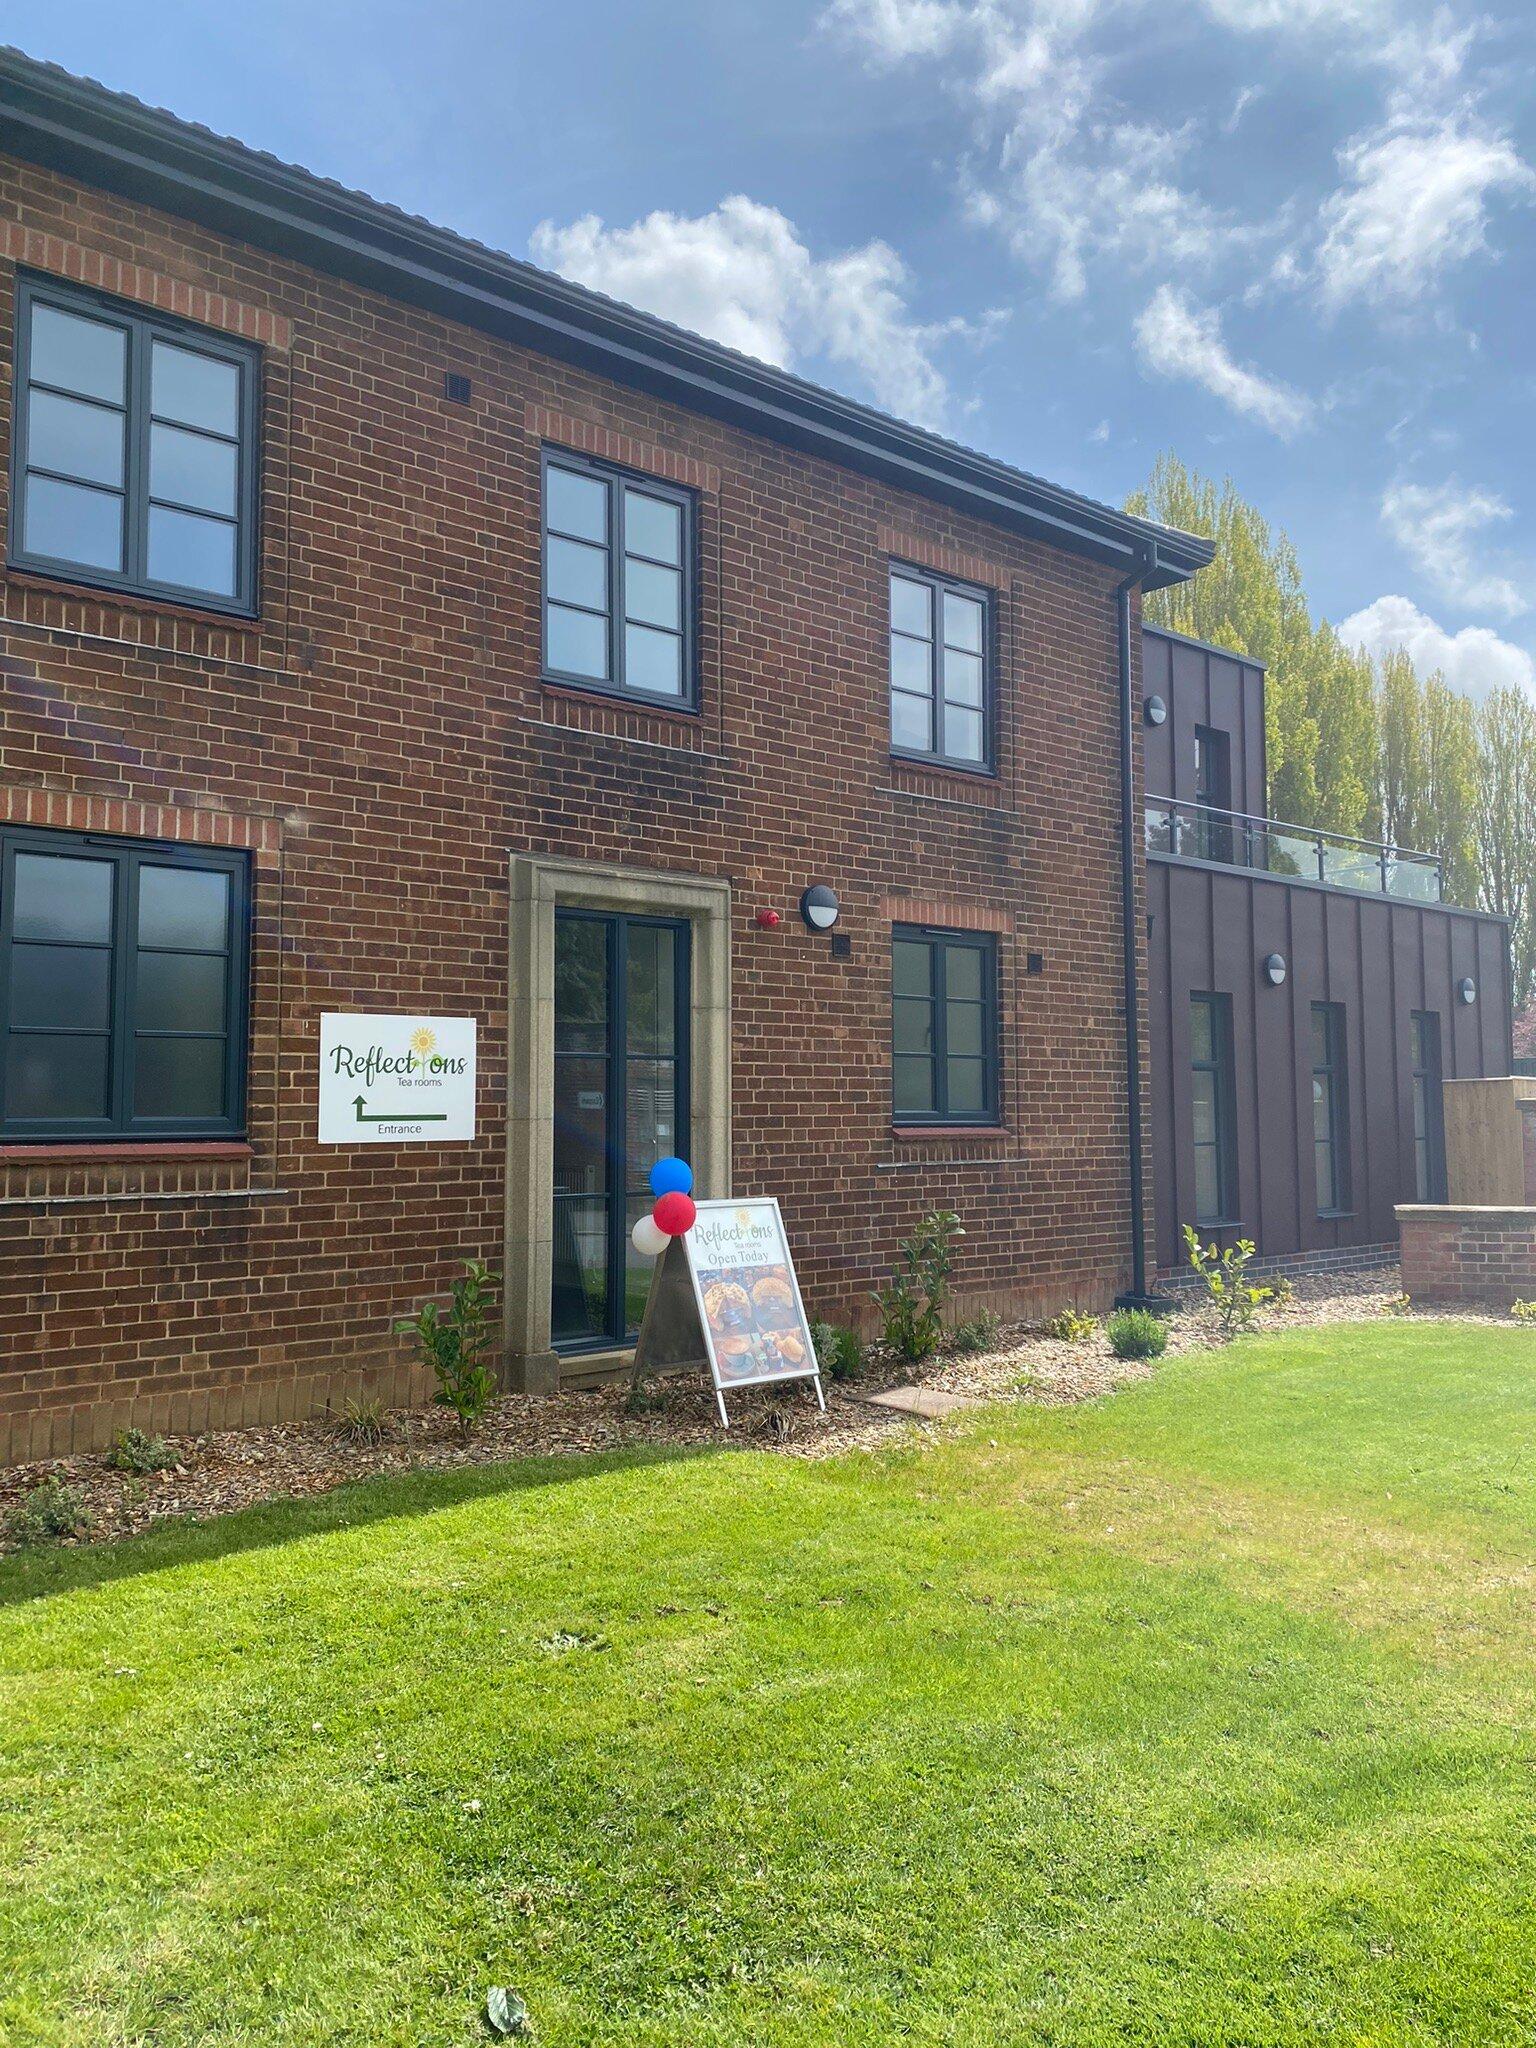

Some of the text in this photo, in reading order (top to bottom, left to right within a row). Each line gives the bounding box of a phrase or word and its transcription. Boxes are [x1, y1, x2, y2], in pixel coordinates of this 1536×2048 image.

[397, 1077, 442, 1087] Tea rooms
[378, 1124, 422, 1134] Entrance
[708, 1250, 769, 1267] Open Today
